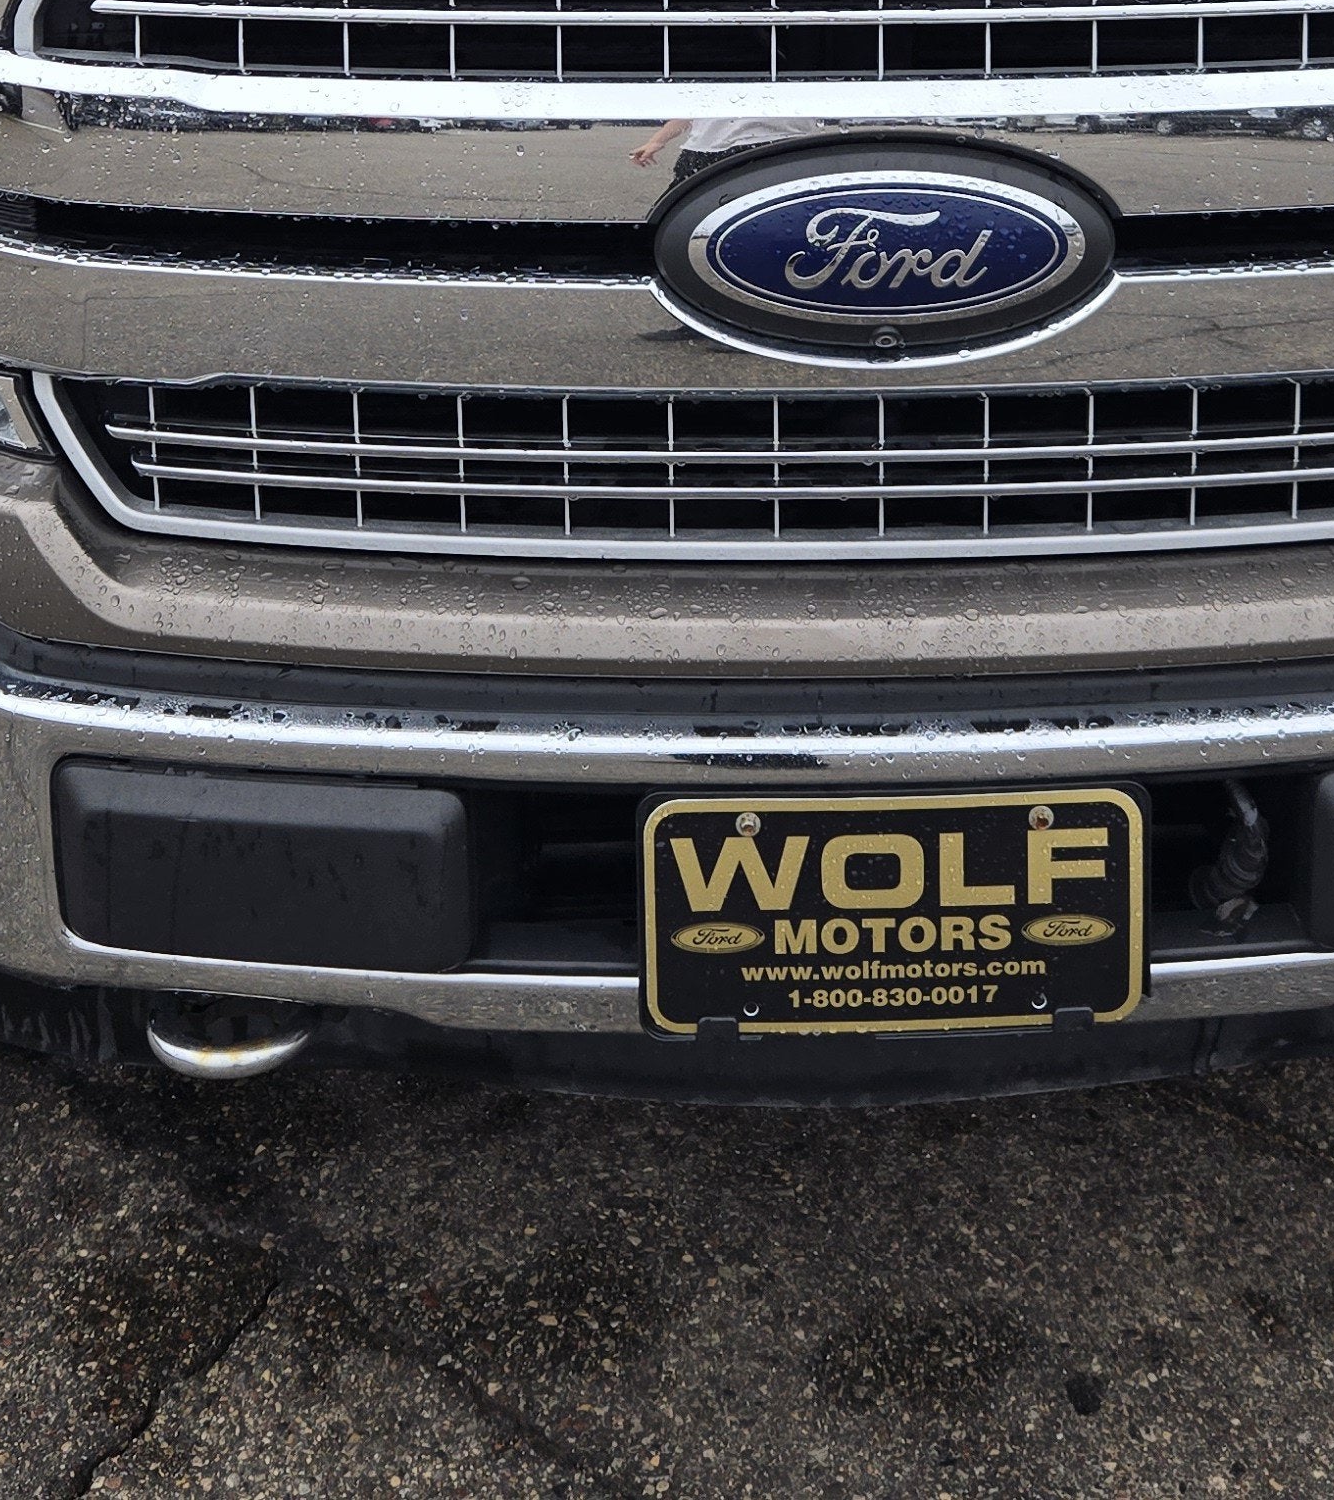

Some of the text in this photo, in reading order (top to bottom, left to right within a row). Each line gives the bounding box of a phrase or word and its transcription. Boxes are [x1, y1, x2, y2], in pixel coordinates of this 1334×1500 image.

[785, 207, 993, 290] Ford
[669, 827, 1109, 912] WOLF
[692, 927, 744, 946] Ford
[774, 914, 1012, 955] MOTORS
[1042, 920, 1093, 939] Ford
[741, 958, 1046, 983] www.wolfmotors.com
[788, 985, 998, 1008] 1-800-830-0017
